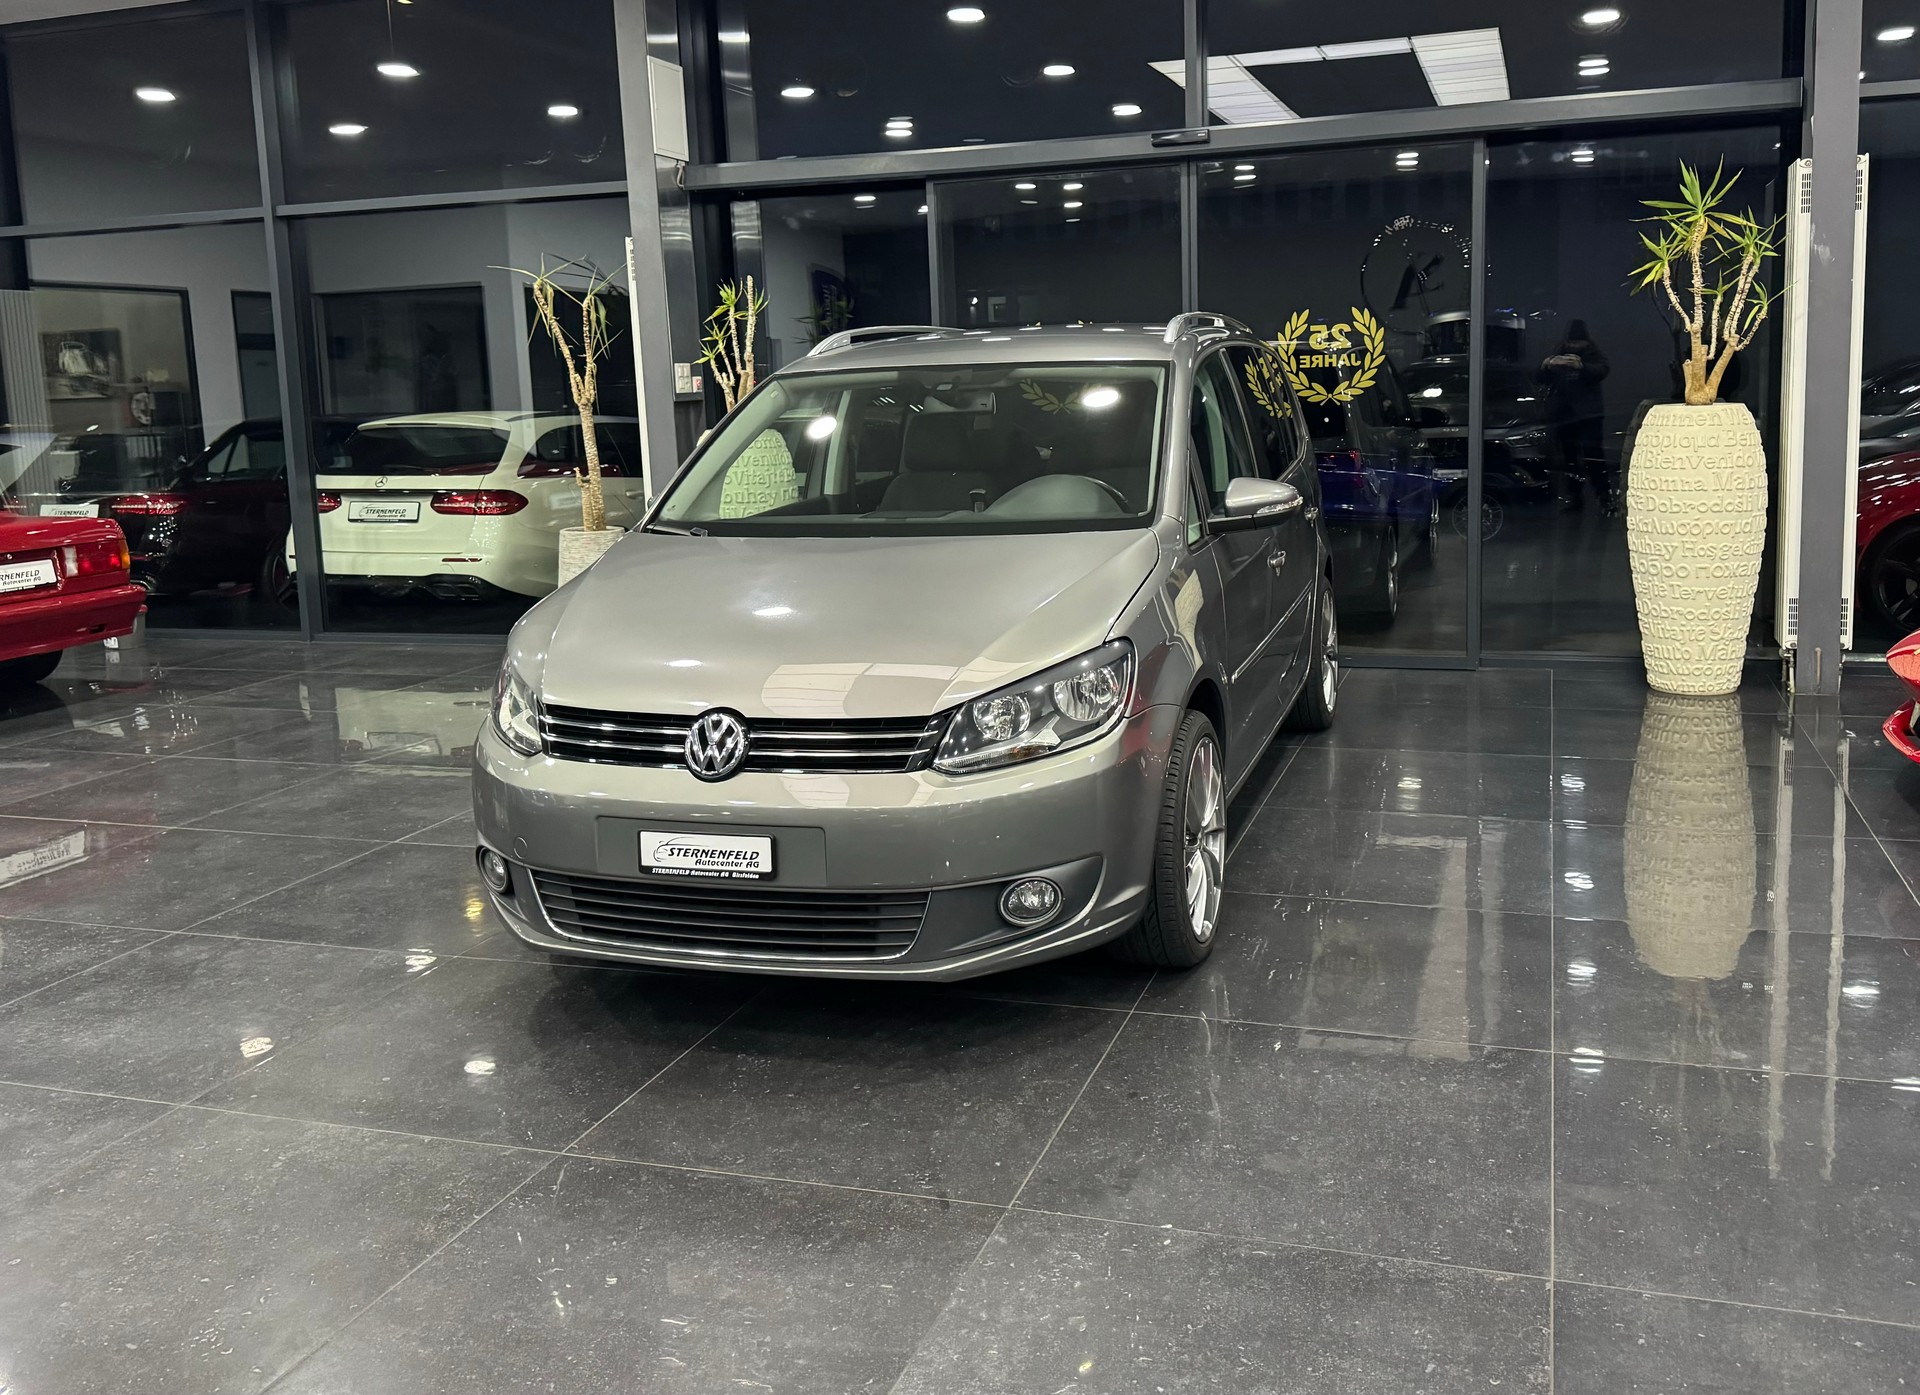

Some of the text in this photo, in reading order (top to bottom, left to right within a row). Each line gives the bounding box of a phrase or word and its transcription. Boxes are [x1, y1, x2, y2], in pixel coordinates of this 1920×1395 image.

[668, 847, 760, 860] STERNENFELD
[695, 859, 760, 869] Autocenter AG
[652, 867, 690, 876] STERNENFELD
